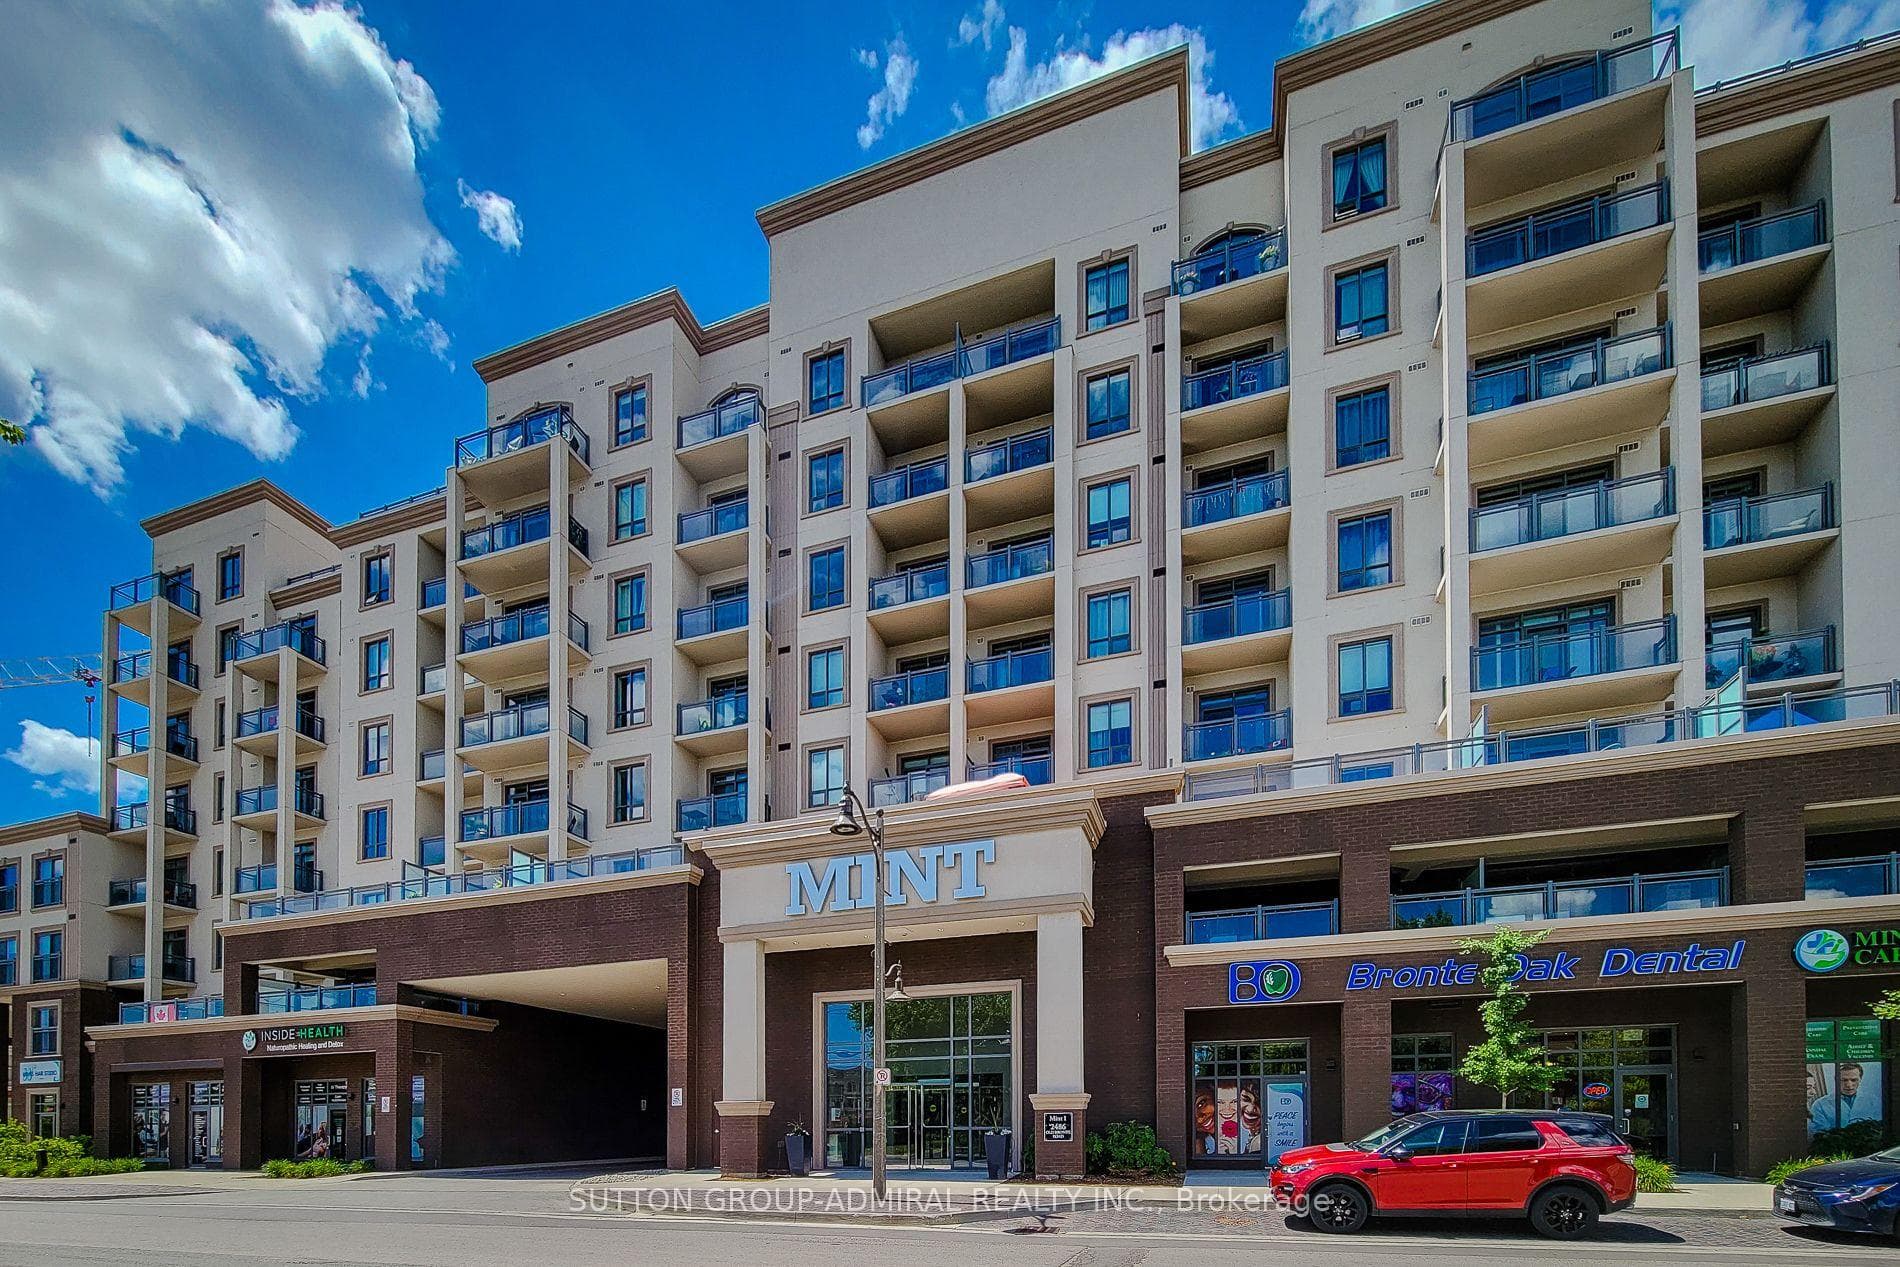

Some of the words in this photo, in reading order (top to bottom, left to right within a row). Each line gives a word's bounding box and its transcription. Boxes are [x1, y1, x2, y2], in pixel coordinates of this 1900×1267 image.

[785, 839, 995, 916] MINT
[1346, 958, 1479, 990] Bronte
[1600, 940, 1746, 977] Dental
[261, 1028, 296, 1041] INSIDE
[299, 1025, 344, 1039] HEALTH
[1273, 1111, 1299, 1120] PEACE
[1273, 1139, 1299, 1147] SMILE
